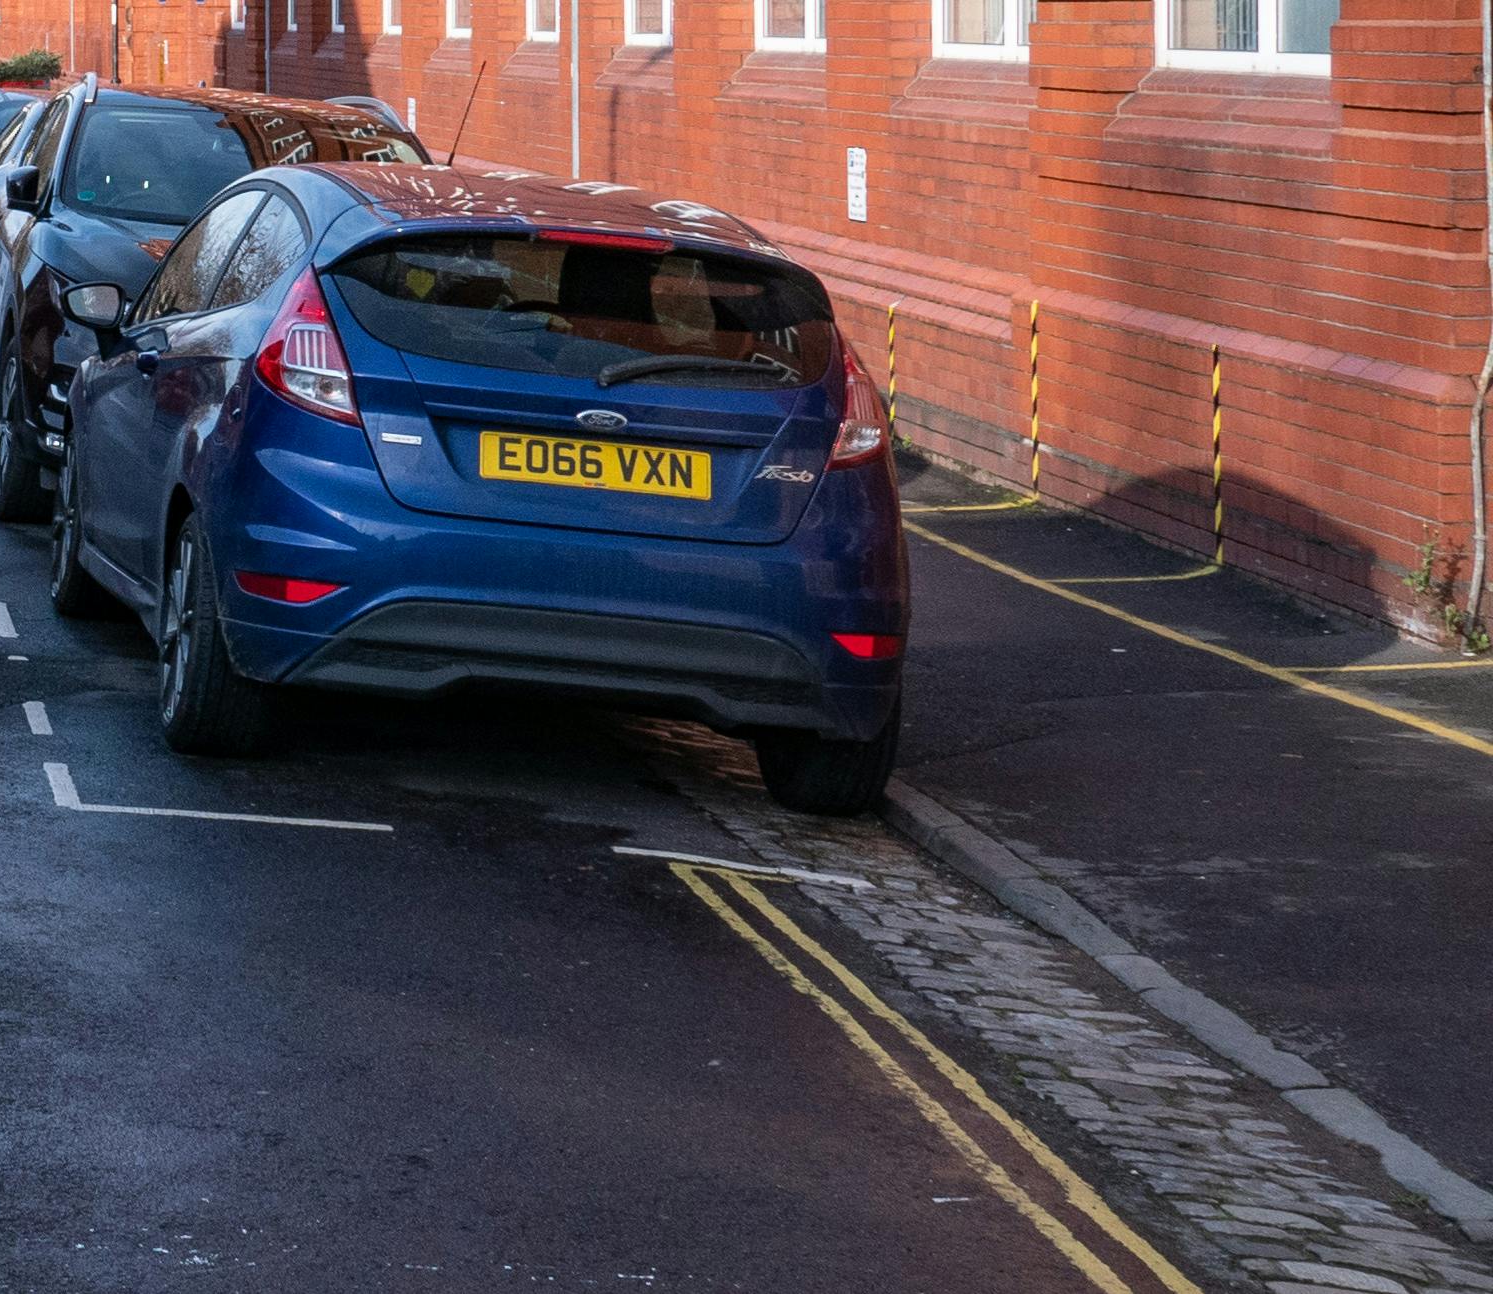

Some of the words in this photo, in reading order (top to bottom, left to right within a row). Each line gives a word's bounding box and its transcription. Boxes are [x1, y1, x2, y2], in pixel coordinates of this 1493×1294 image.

[587, 412, 618, 427] Ford
[498, 436, 603, 478] EO66
[616, 447, 693, 489] VXN
